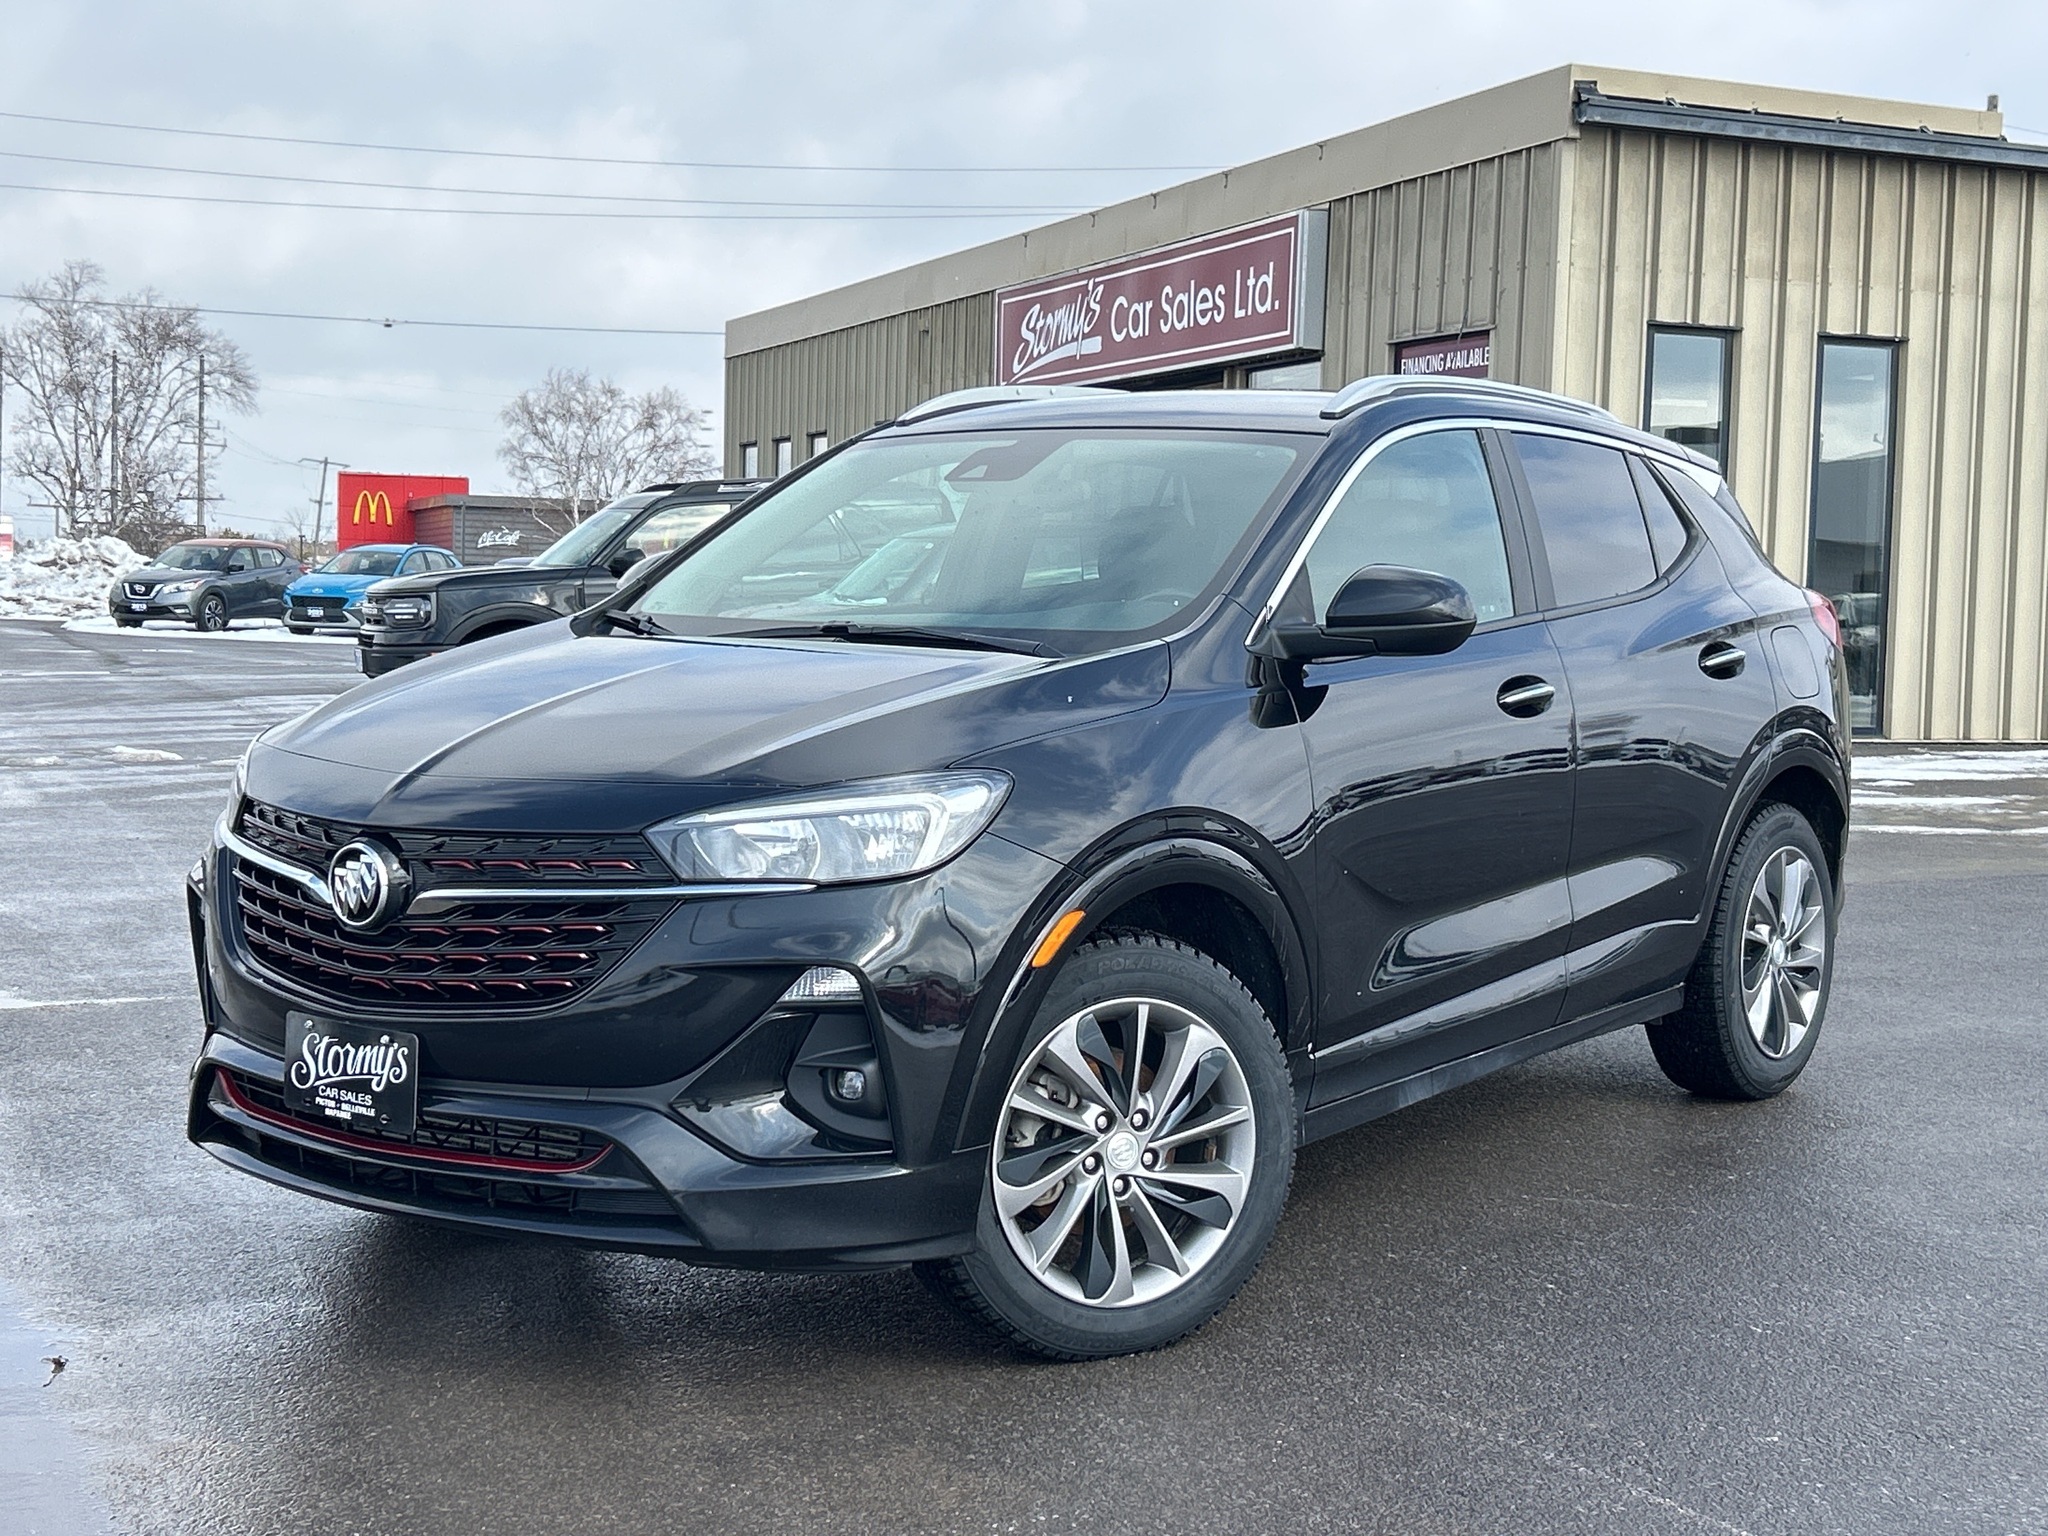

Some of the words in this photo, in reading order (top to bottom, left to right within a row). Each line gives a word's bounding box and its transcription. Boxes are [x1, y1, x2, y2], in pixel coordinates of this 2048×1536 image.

[1012, 278, 1104, 374] Stormy's
[1110, 296, 1153, 343] Car
[1159, 280, 1227, 335] Sales
[1234, 261, 1280, 320] Ltd.
[1401, 353, 1444, 375] FINANCING
[1445, 346, 1489, 371] AVAILABLE
[290, 1032, 409, 1092] Stormy's
[318, 1085, 339, 1099] CAR
[339, 1089, 373, 1106] SALES
